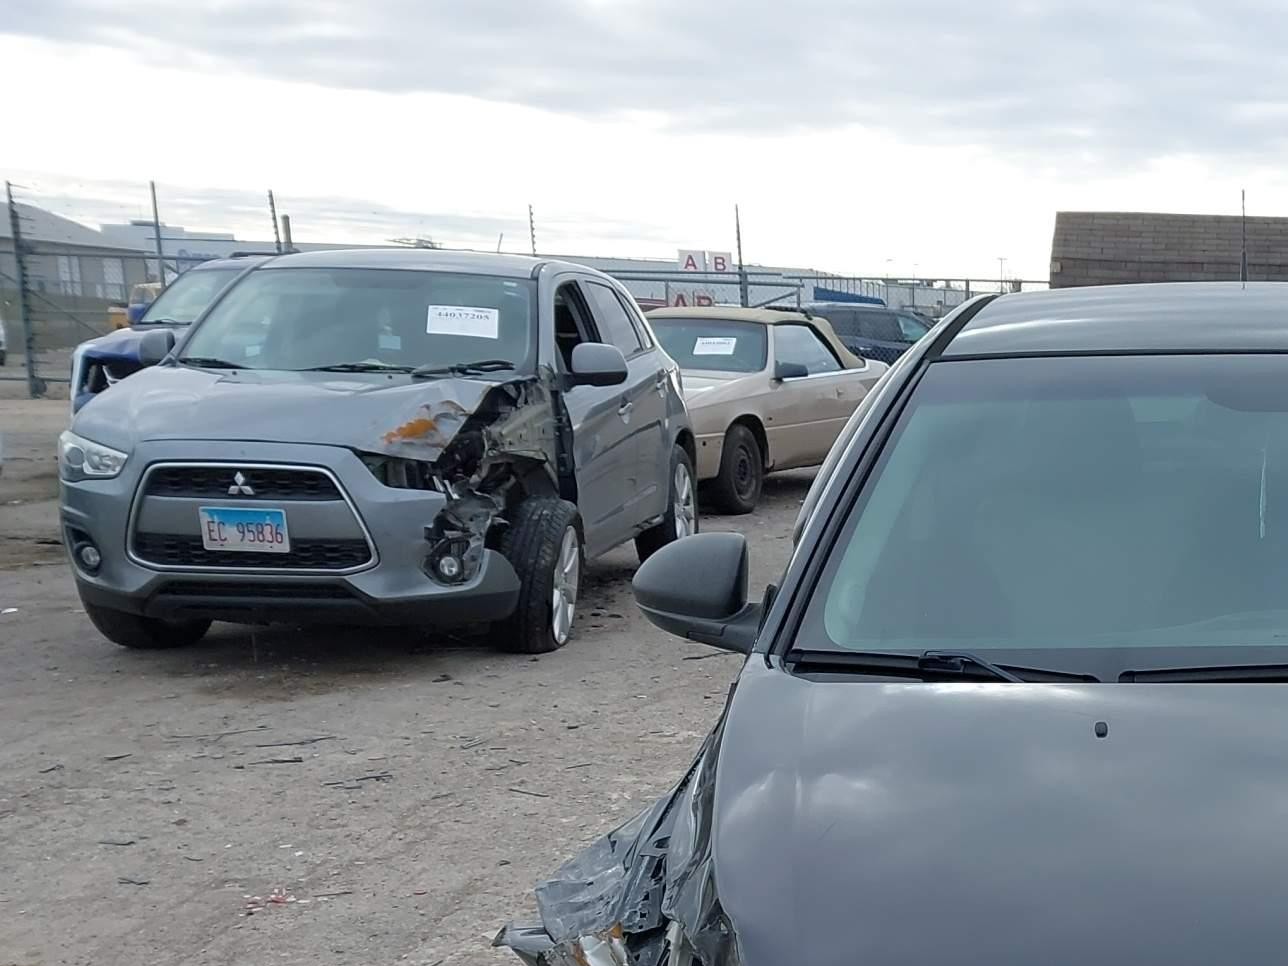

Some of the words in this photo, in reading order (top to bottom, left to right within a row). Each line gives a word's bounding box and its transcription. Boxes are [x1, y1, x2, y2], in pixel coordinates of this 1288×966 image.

[683, 255, 697, 270] A
[714, 256, 727, 272] B
[207, 520, 228, 542] EC
[236, 522, 284, 544] 95836
